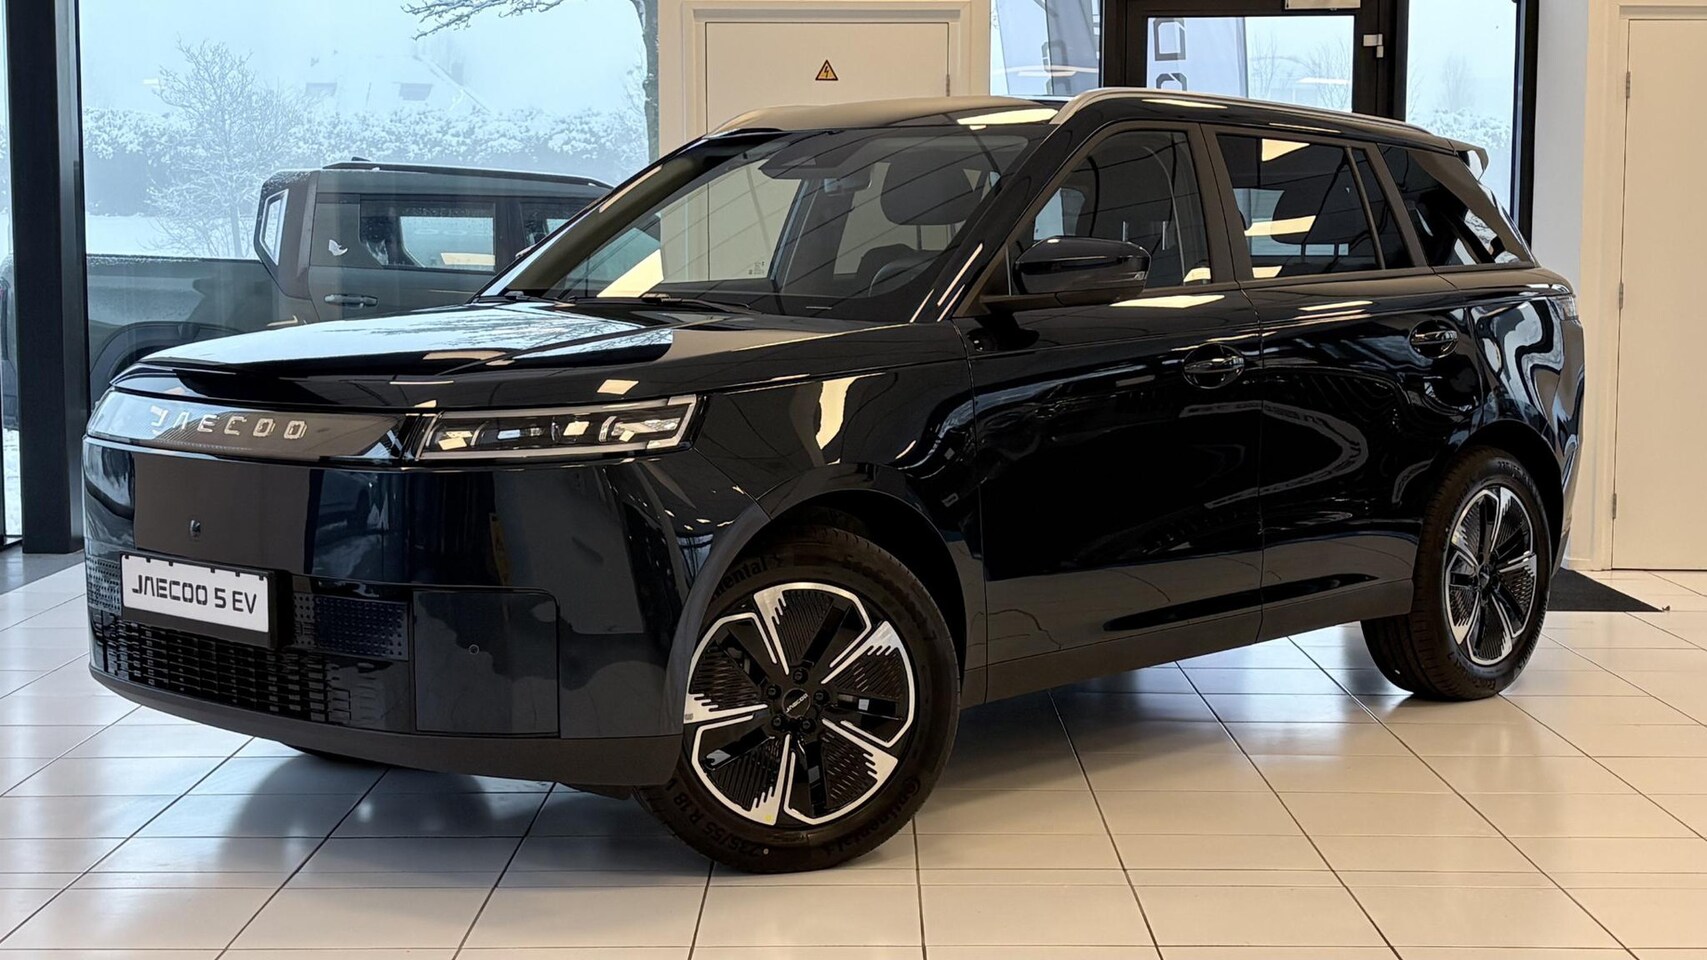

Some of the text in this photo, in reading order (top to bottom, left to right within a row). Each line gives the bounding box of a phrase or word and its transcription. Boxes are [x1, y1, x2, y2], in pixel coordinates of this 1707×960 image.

[150, 405, 307, 440] JAECOO
[132, 574, 257, 614] JAECOO 5 EV
